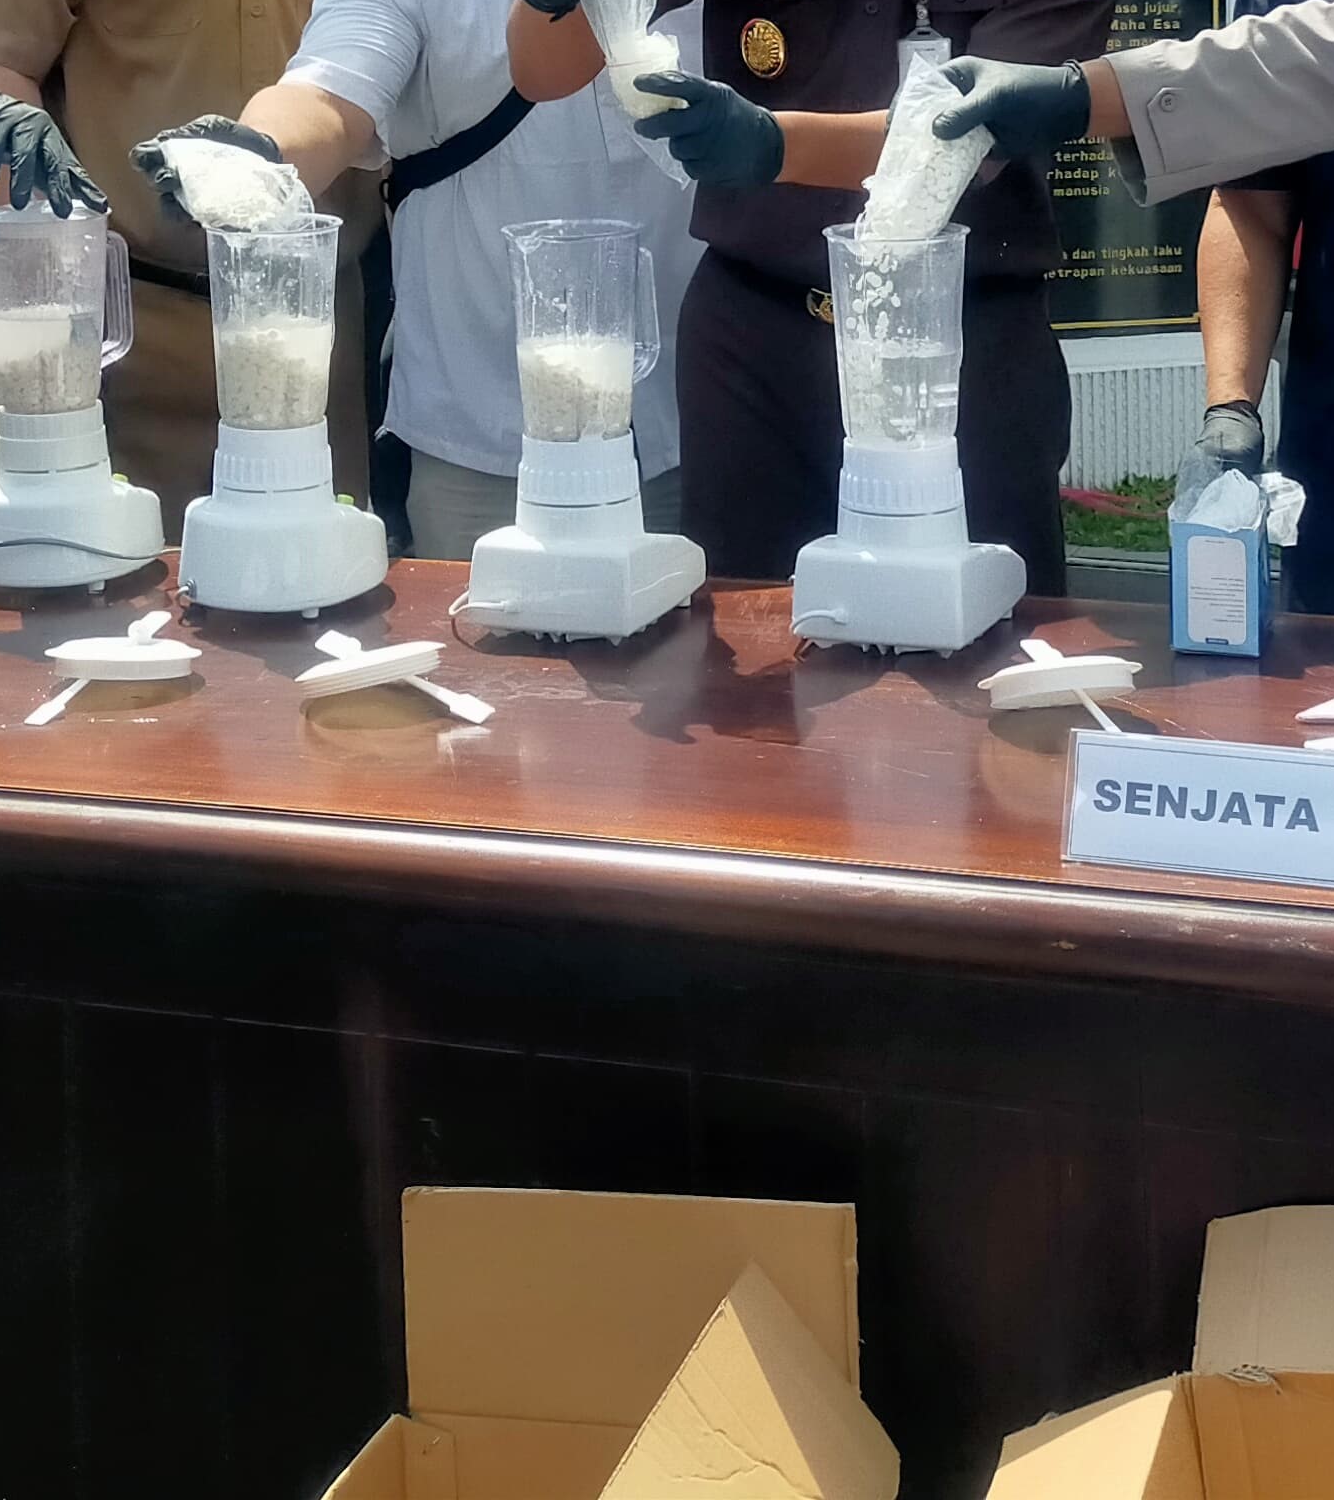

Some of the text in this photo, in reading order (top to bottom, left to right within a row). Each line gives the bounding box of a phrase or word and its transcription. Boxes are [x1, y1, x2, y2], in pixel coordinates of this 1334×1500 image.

[1114, 3, 1138, 14] asa
[1153, 18, 1181, 30] Esa
[1055, 150, 1115, 163] terhada
[1046, 168, 1100, 181] rhadap
[1053, 185, 1110, 197] manusia
[1072, 247, 1096, 260] dan
[1101, 247, 1149, 261] tingkah
[1154, 245, 1182, 257] laku
[1111, 264, 1183, 276] kekuasaan
[1092, 777, 1319, 833] SENJATA
